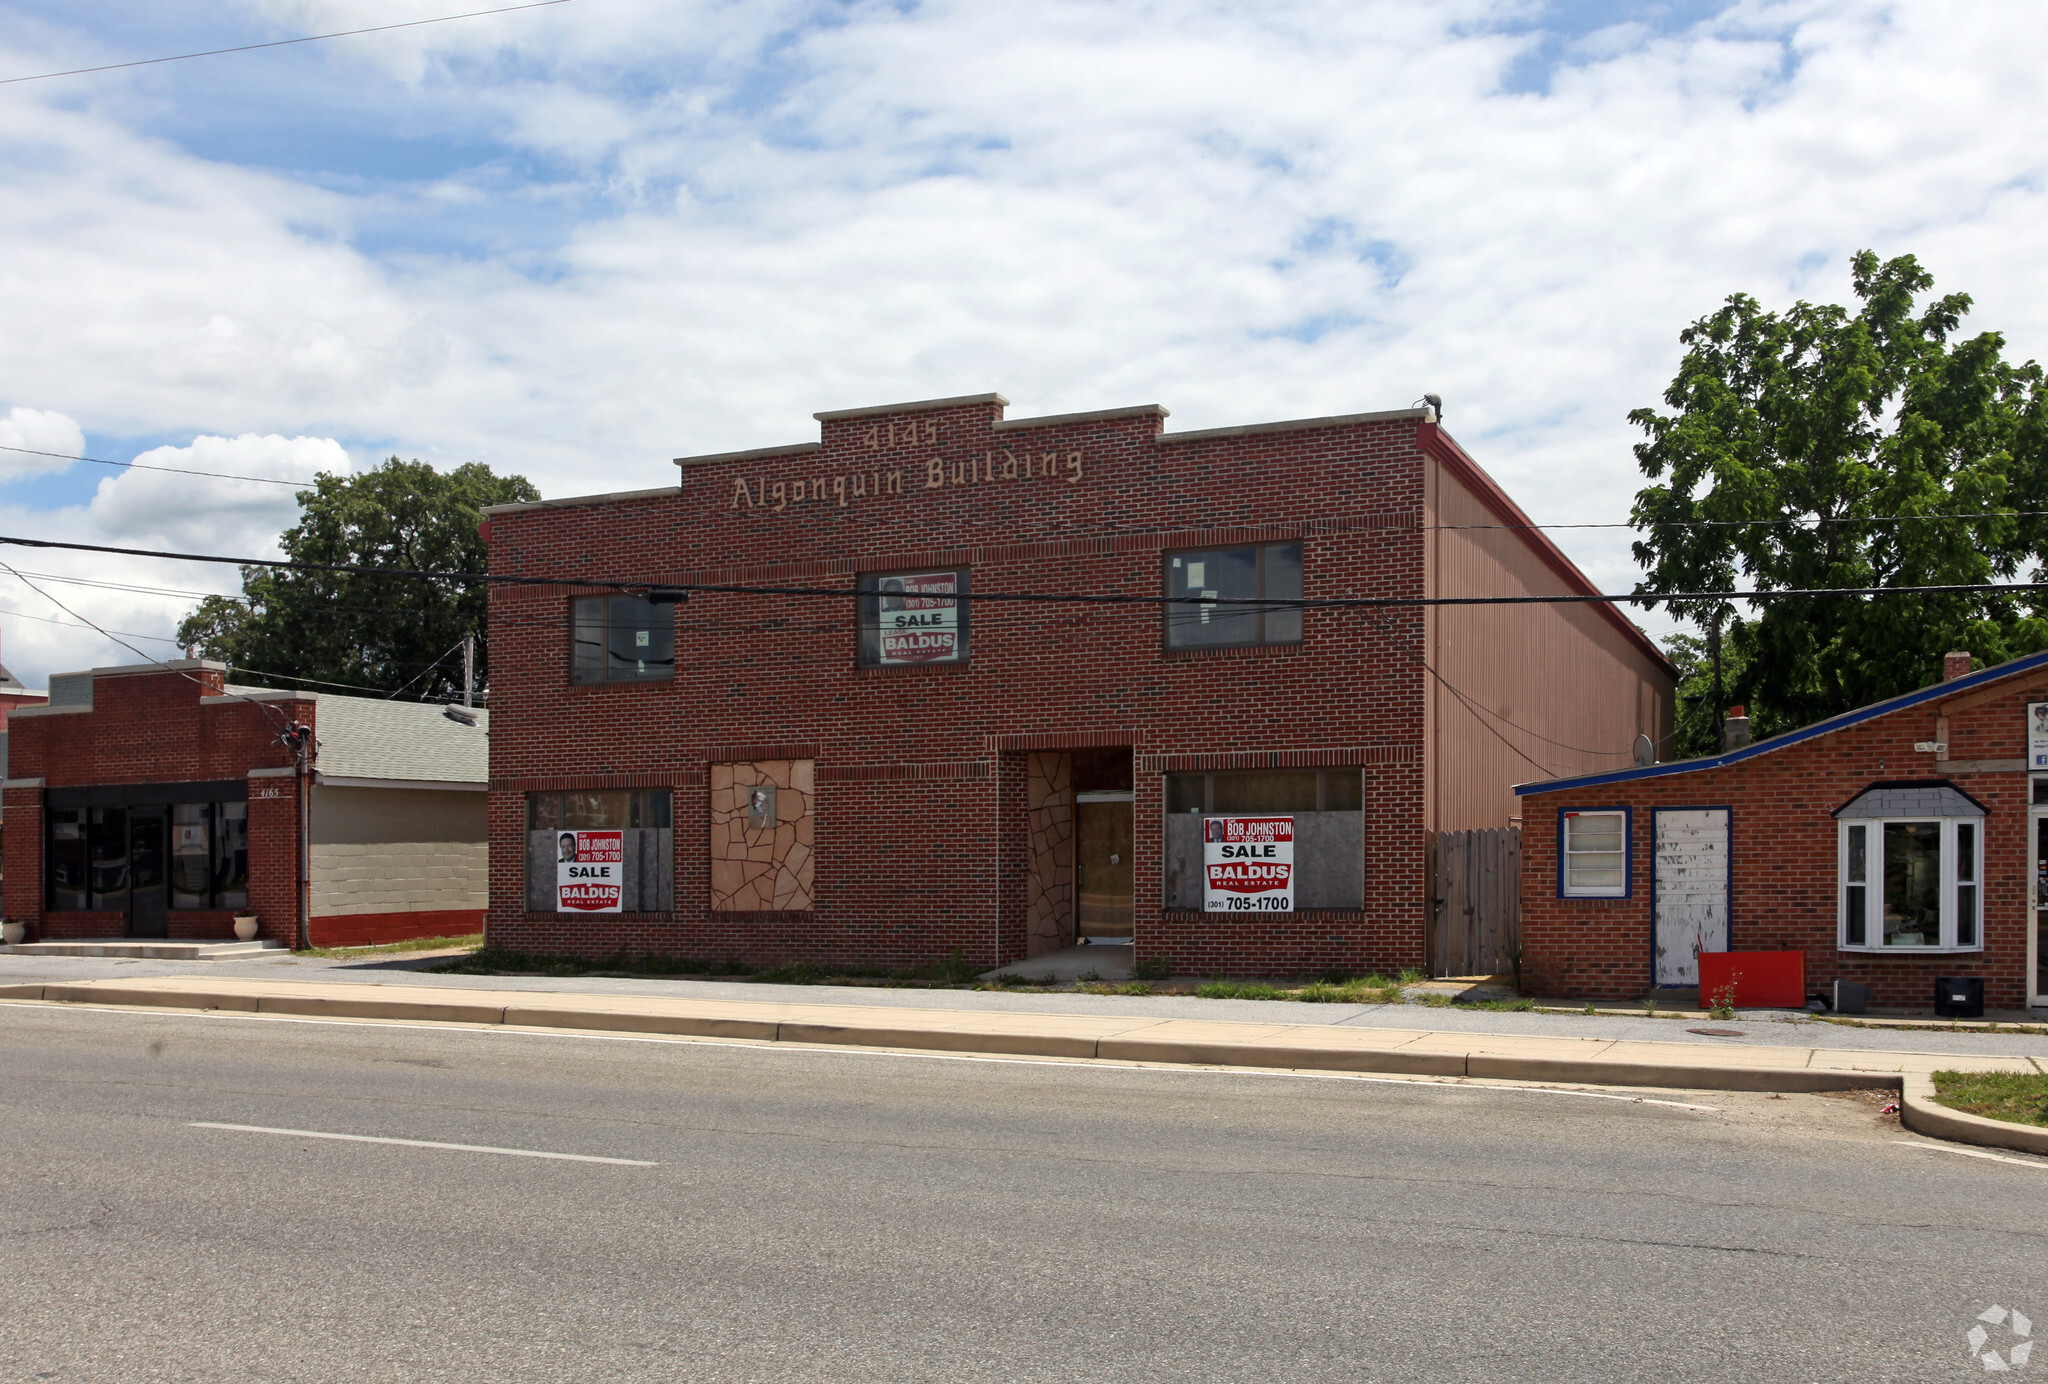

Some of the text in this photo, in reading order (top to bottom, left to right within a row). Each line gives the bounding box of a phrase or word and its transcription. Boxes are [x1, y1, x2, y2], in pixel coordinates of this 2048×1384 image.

[864, 419, 939, 450] 4145
[730, 445, 1083, 512] Algonquin Building
[921, 582, 954, 594] JOHNSTON
[921, 597, 953, 607] 705-1700
[895, 613, 942, 627] SALE
[886, 634, 953, 650] BALDUS
[260, 788, 279, 797] 4165
[1227, 822, 1291, 836] BOB JOHNSTON
[579, 839, 620, 850] BOB JOHNSTON
[579, 851, 620, 861] (301) 705-1700
[1221, 845, 1276, 858] SALE
[569, 867, 610, 878] SALE
[1210, 865, 1289, 879] BALDUS
[561, 887, 618, 899] BALDUS
[1208, 897, 1289, 910] (301) 705-1700
